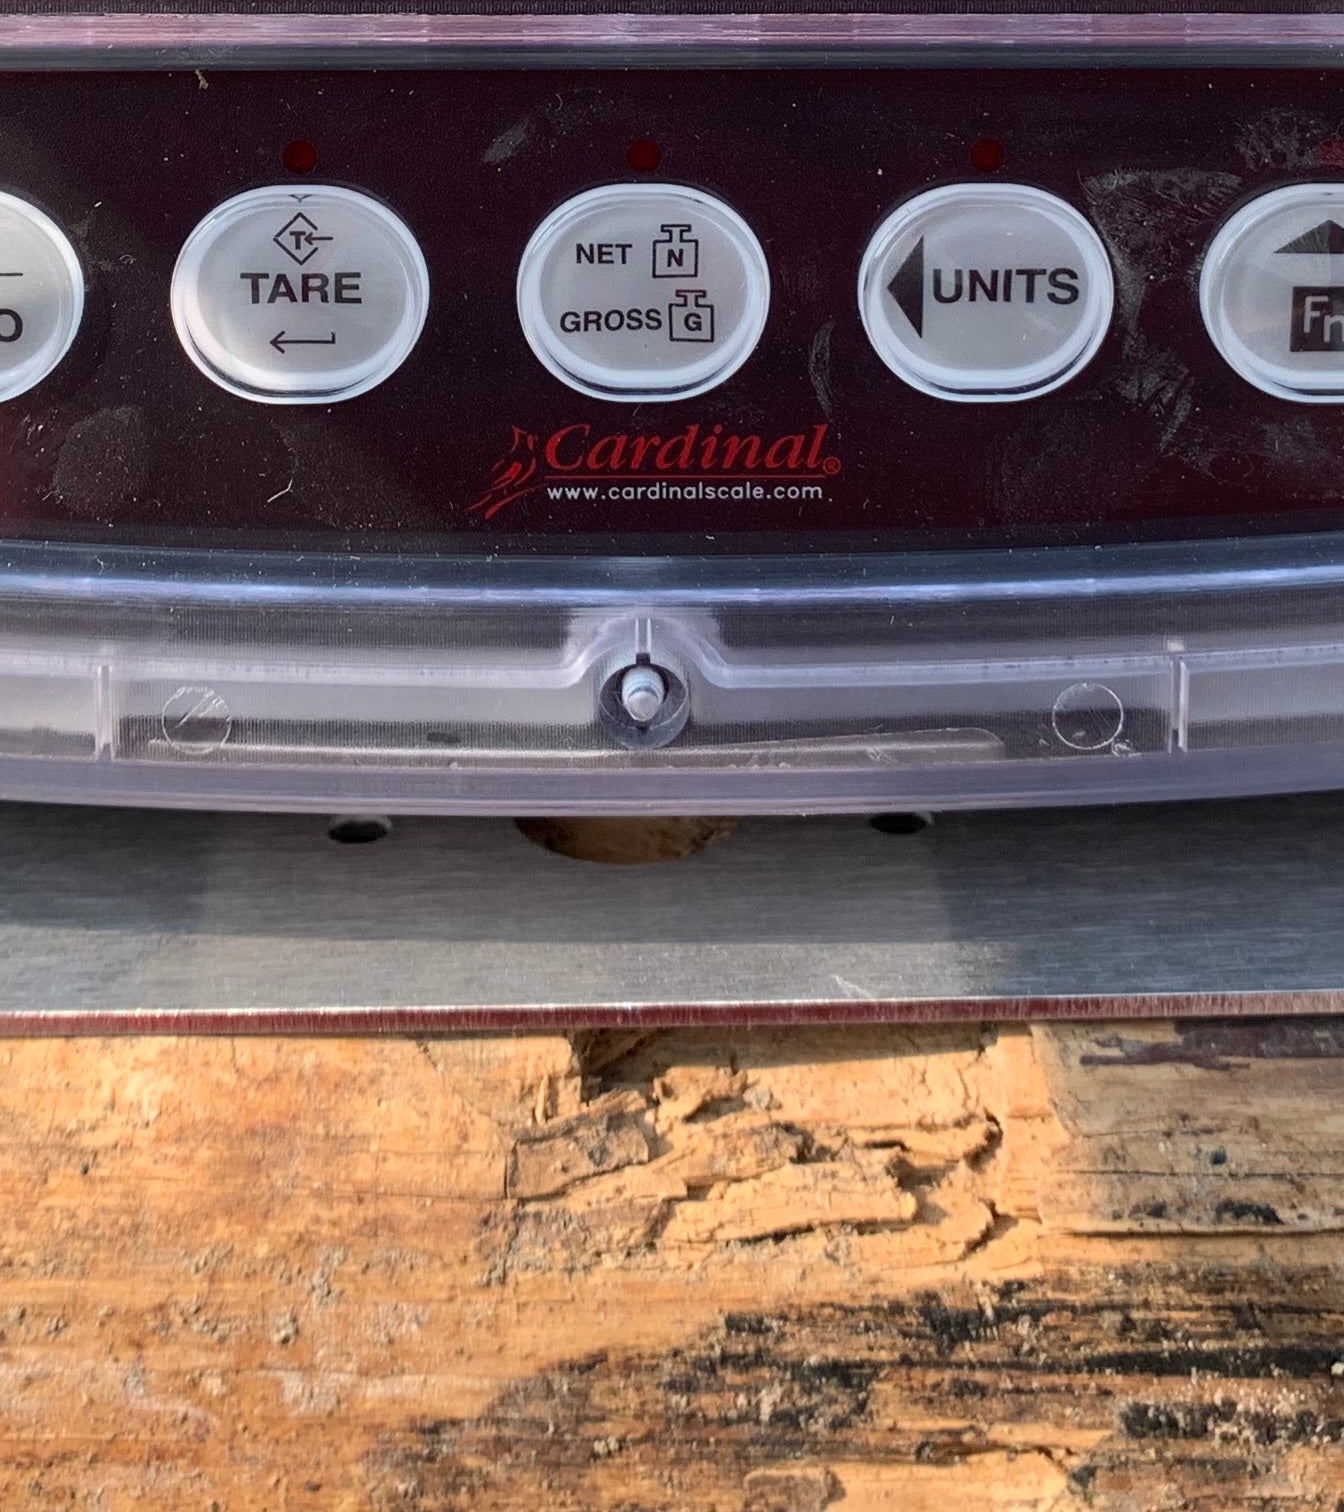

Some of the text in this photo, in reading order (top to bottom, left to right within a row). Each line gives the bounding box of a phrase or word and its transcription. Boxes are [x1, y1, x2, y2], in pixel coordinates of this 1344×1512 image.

[575, 242, 633, 266] NET
[667, 249, 685, 268] N
[240, 271, 362, 305] TARE
[932, 266, 1080, 306] UNITS
[559, 309, 663, 335] GROSS
[683, 313, 703, 332] G
[547, 482, 823, 501] www.cardinalscale.com
